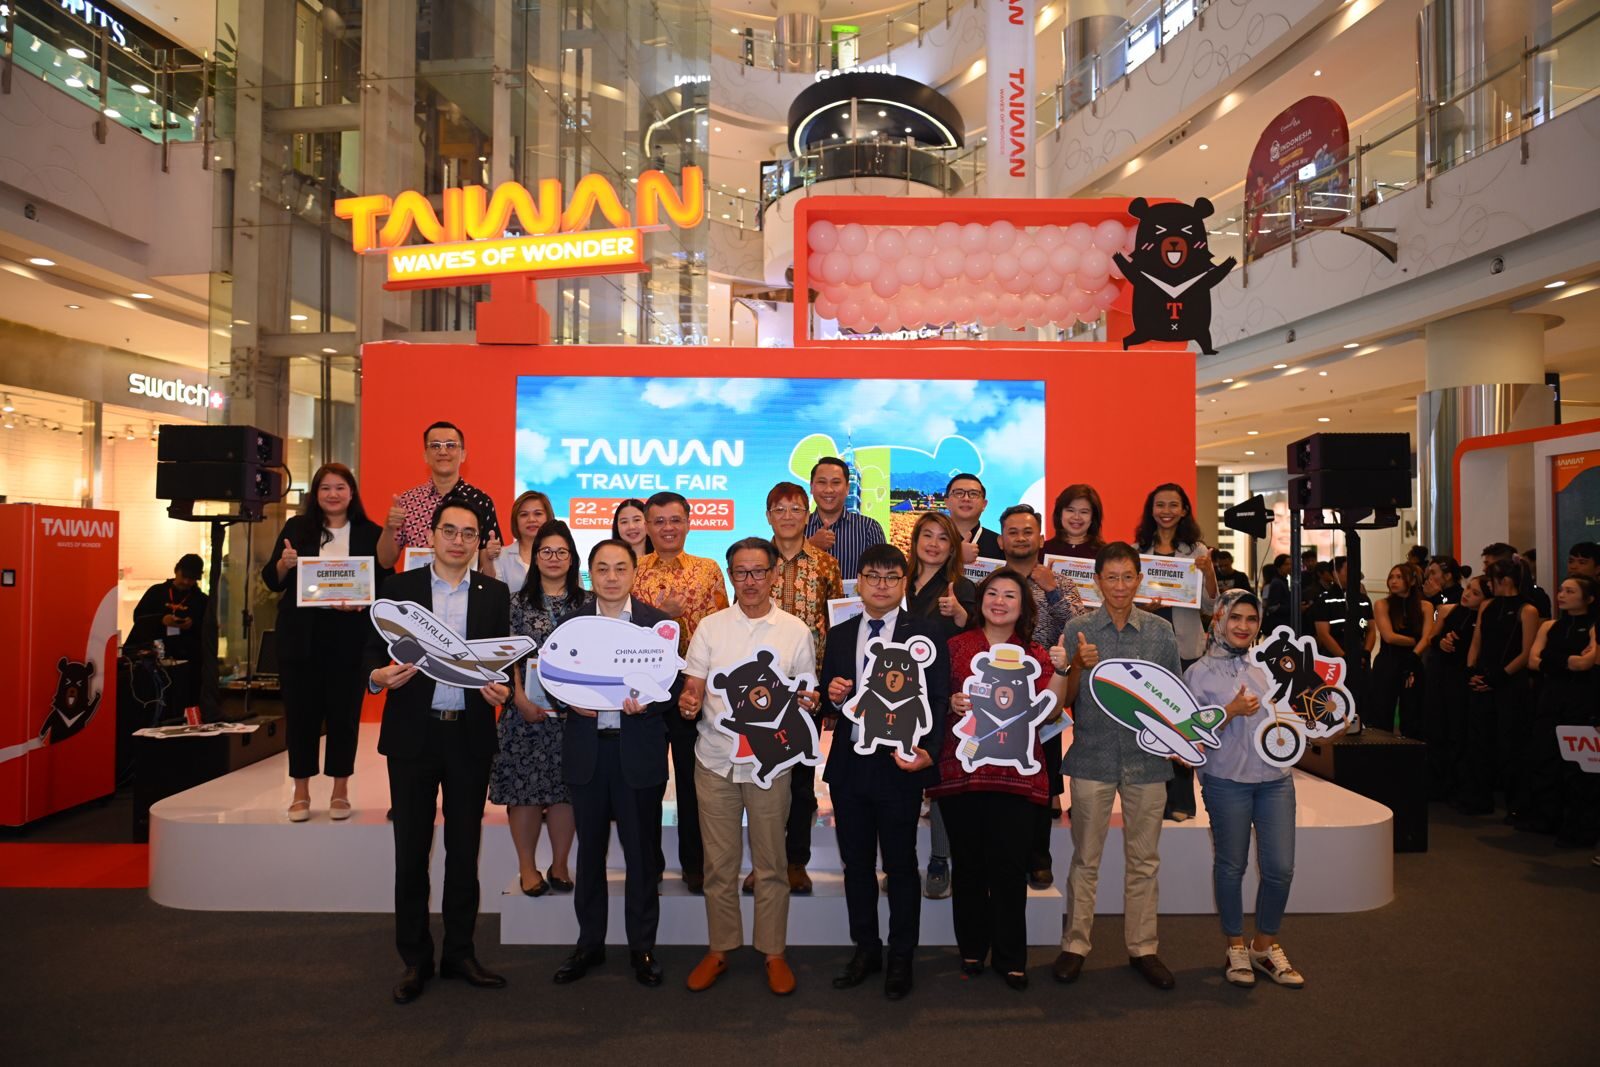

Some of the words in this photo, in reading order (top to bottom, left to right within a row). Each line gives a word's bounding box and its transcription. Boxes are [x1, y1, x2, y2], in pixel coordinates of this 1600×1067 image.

[1008, 68, 1025, 178] TAIWAN
[335, 166, 704, 254] TAIWAN
[393, 251, 476, 273] WAVES
[482, 246, 525, 266] OF
[531, 237, 635, 263] WONDER
[128, 373, 210, 408] swatch
[561, 438, 745, 467] TAIWAN
[576, 473, 670, 490] TRAVEL
[675, 474, 728, 491] FAIR
[575, 502, 597, 514] 22
[41, 517, 114, 538] TAIWAN
[575, 517, 614, 526] CENTRA
[316, 569, 356, 578] CERTIFICATE
[1060, 568, 1095, 579] CERTIFICAT
[1147, 568, 1185, 578] CERTIFICATE
[410, 610, 453, 648] STARLUX
[1143, 680, 1163, 699] EVA
[1162, 697, 1181, 714] AIR
